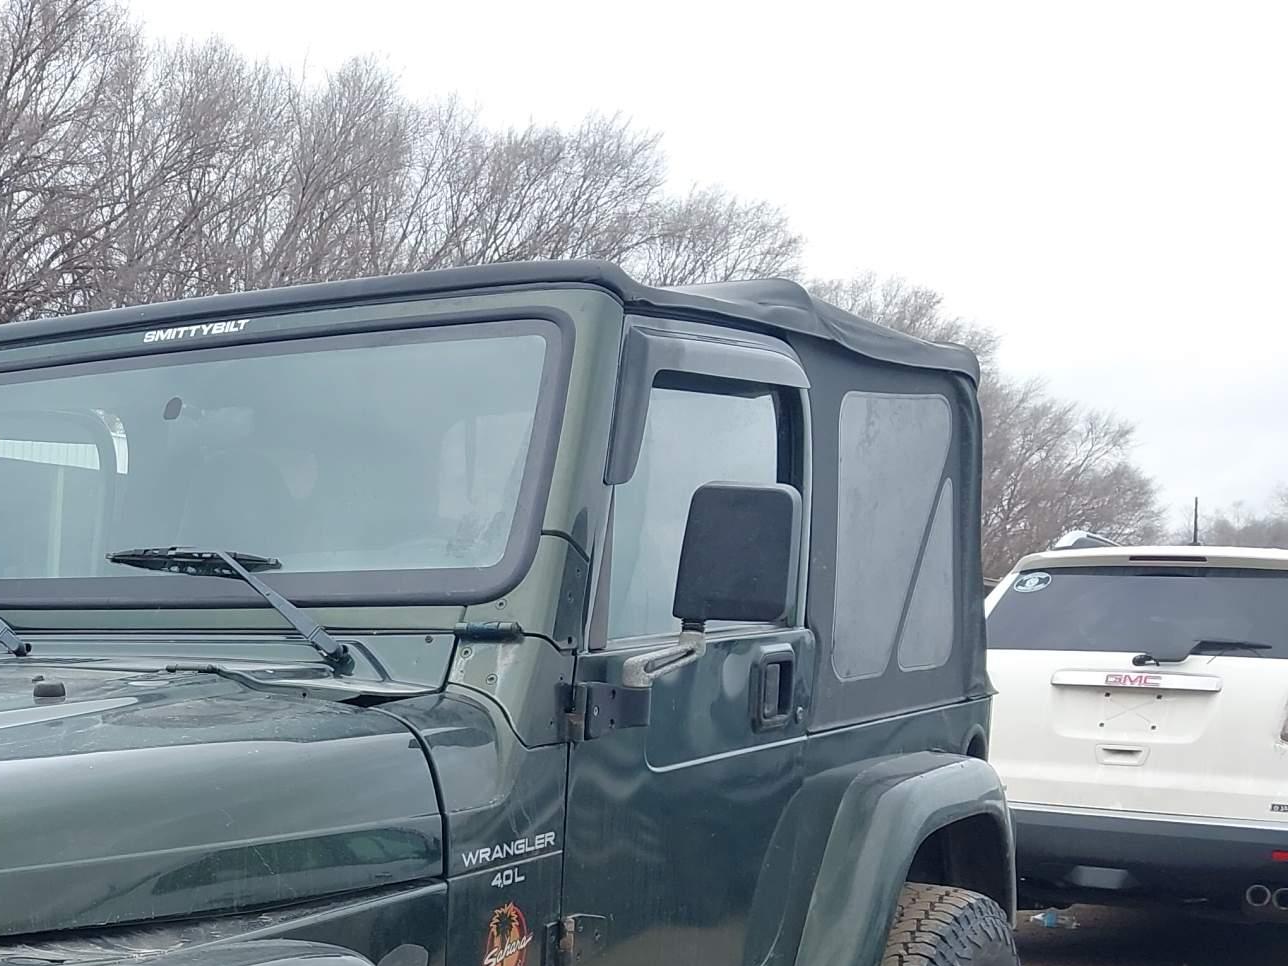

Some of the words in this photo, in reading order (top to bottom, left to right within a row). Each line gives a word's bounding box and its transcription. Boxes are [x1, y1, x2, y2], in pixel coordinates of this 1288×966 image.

[143, 319, 250, 343] SMITTYBILT
[1105, 674, 1162, 687] GMC
[461, 831, 556, 868] WRANGLER
